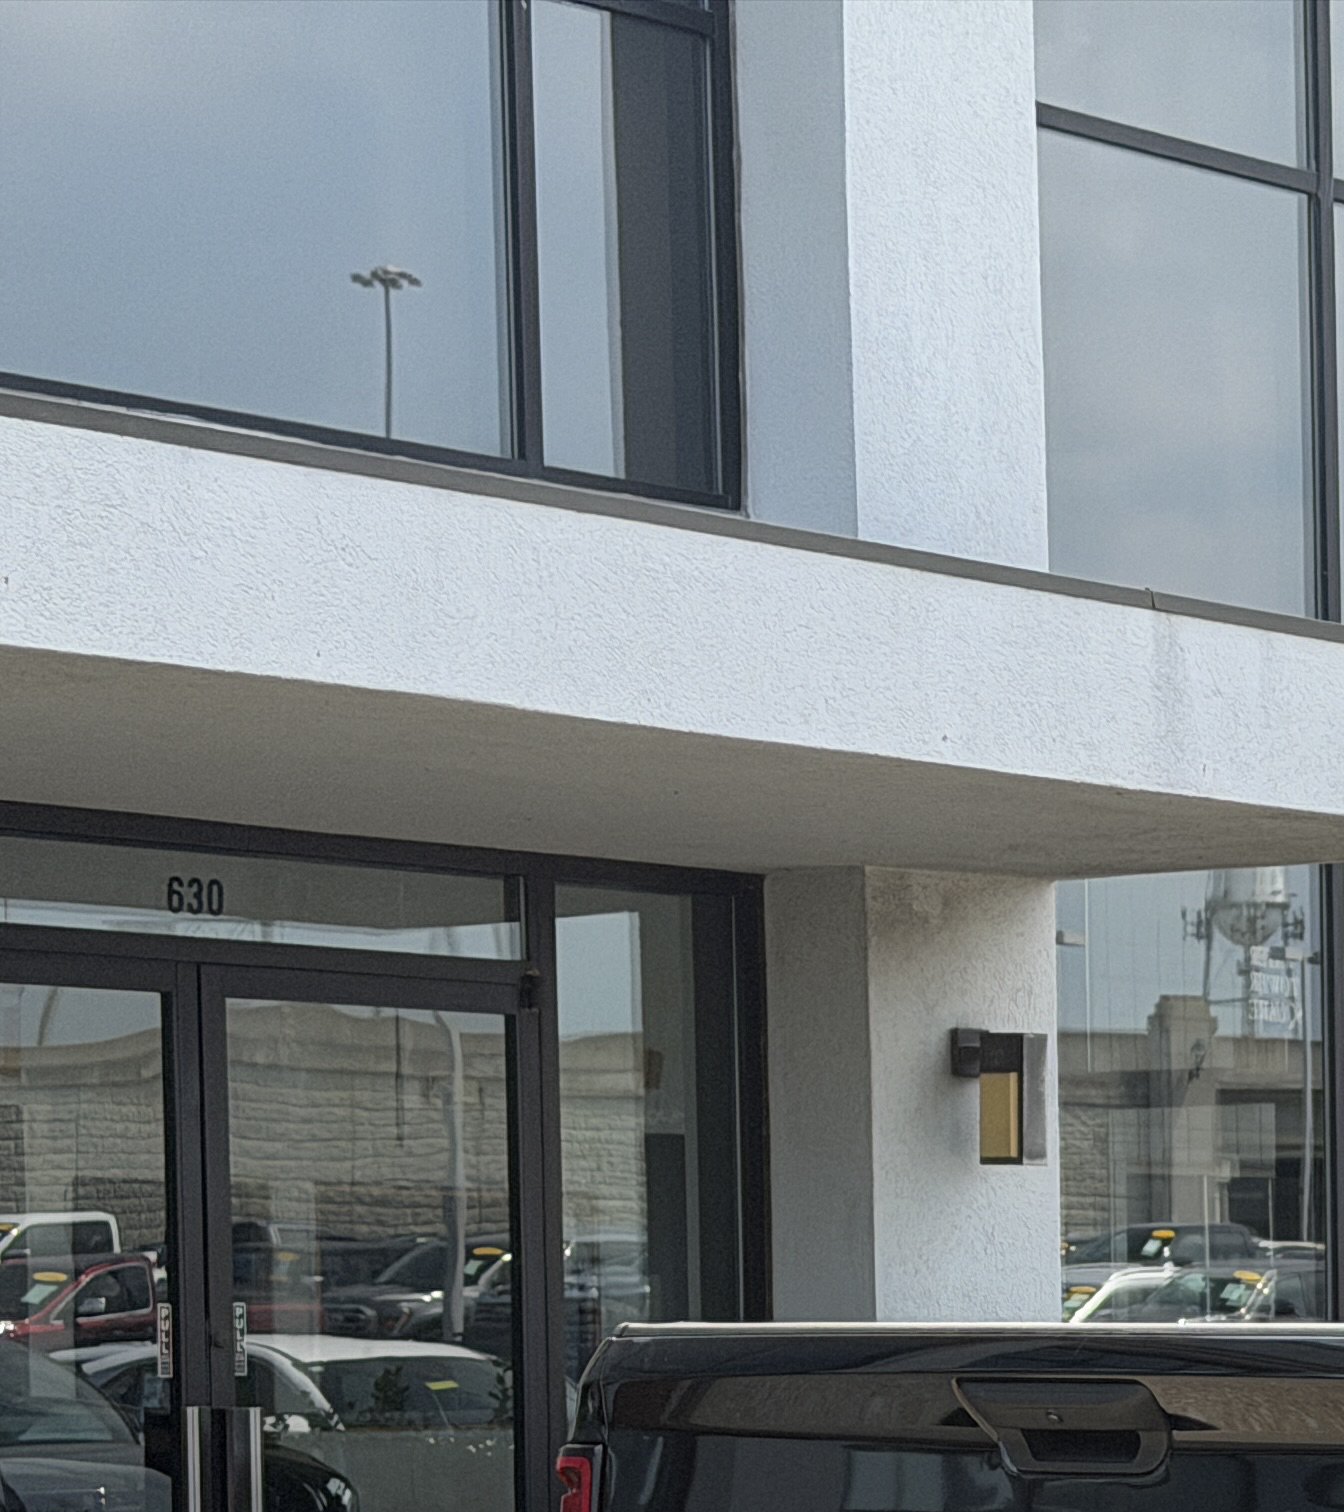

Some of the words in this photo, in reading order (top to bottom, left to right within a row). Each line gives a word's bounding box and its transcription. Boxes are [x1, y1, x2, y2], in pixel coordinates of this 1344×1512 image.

[167, 876, 224, 916] 630
[161, 1307, 170, 1354] PULL
[235, 1306, 244, 1353] PULL
